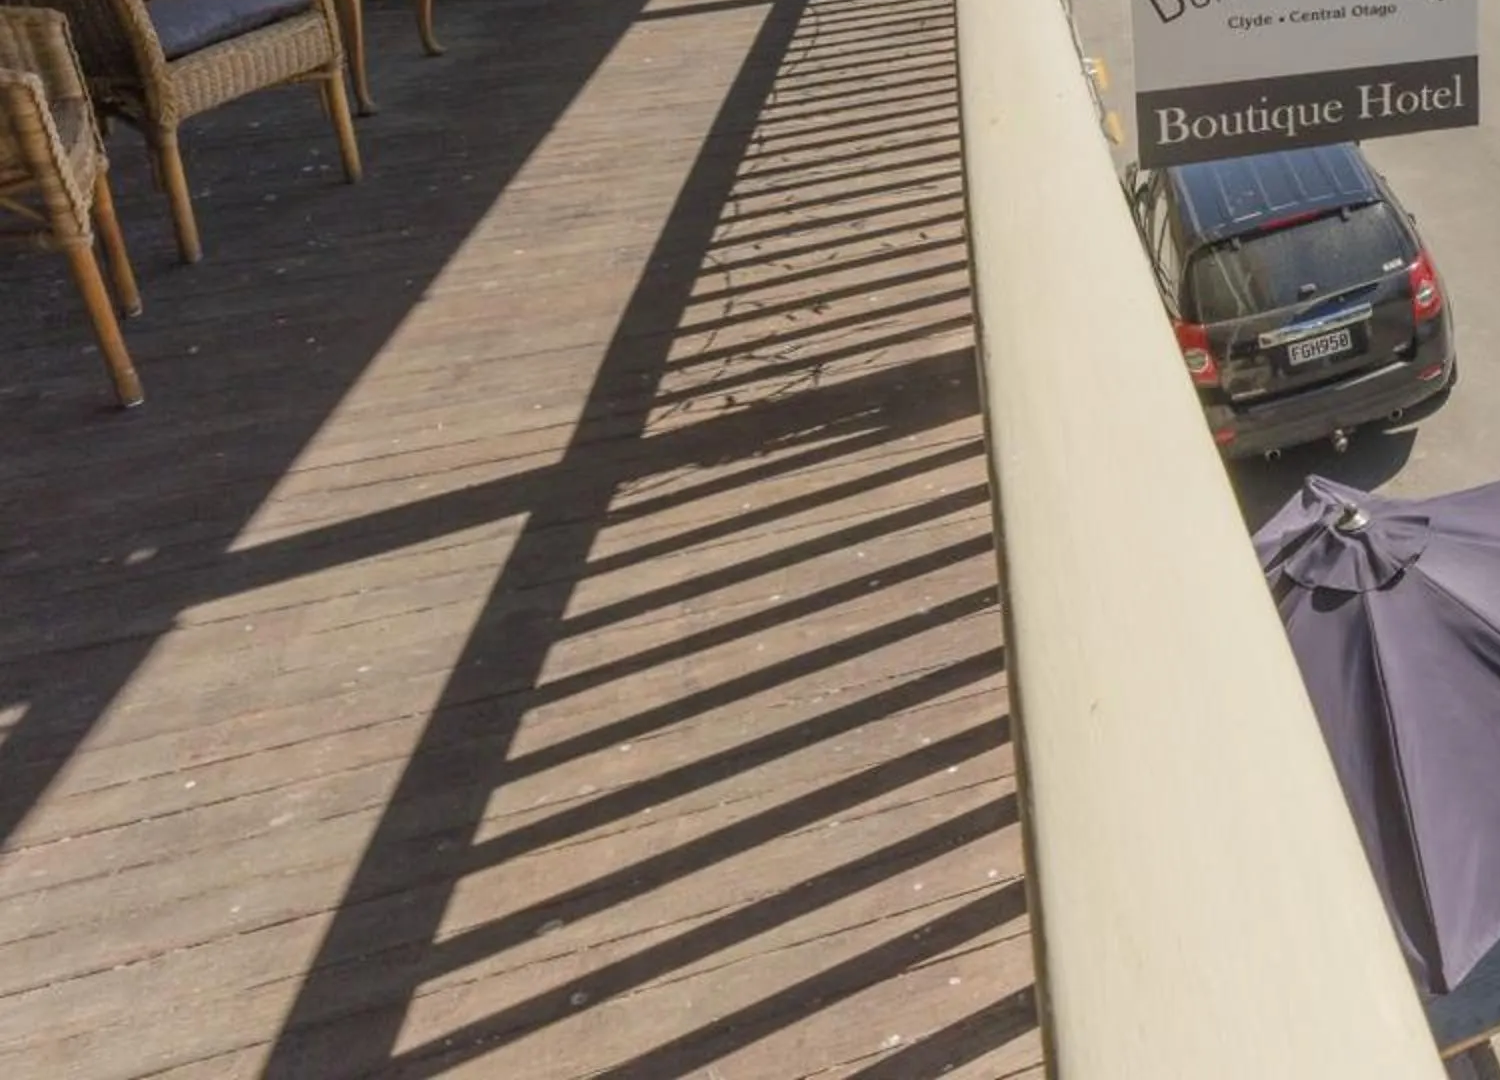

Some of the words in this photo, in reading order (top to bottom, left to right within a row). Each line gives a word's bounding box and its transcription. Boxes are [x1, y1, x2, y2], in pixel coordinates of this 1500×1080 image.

[1227, 14, 1274, 31] Clyde
[1288, 6, 1347, 23] Central
[1350, 4, 1398, 19] Otago
[1156, 96, 1345, 146] Boutique
[1357, 74, 1465, 120] Hotel
